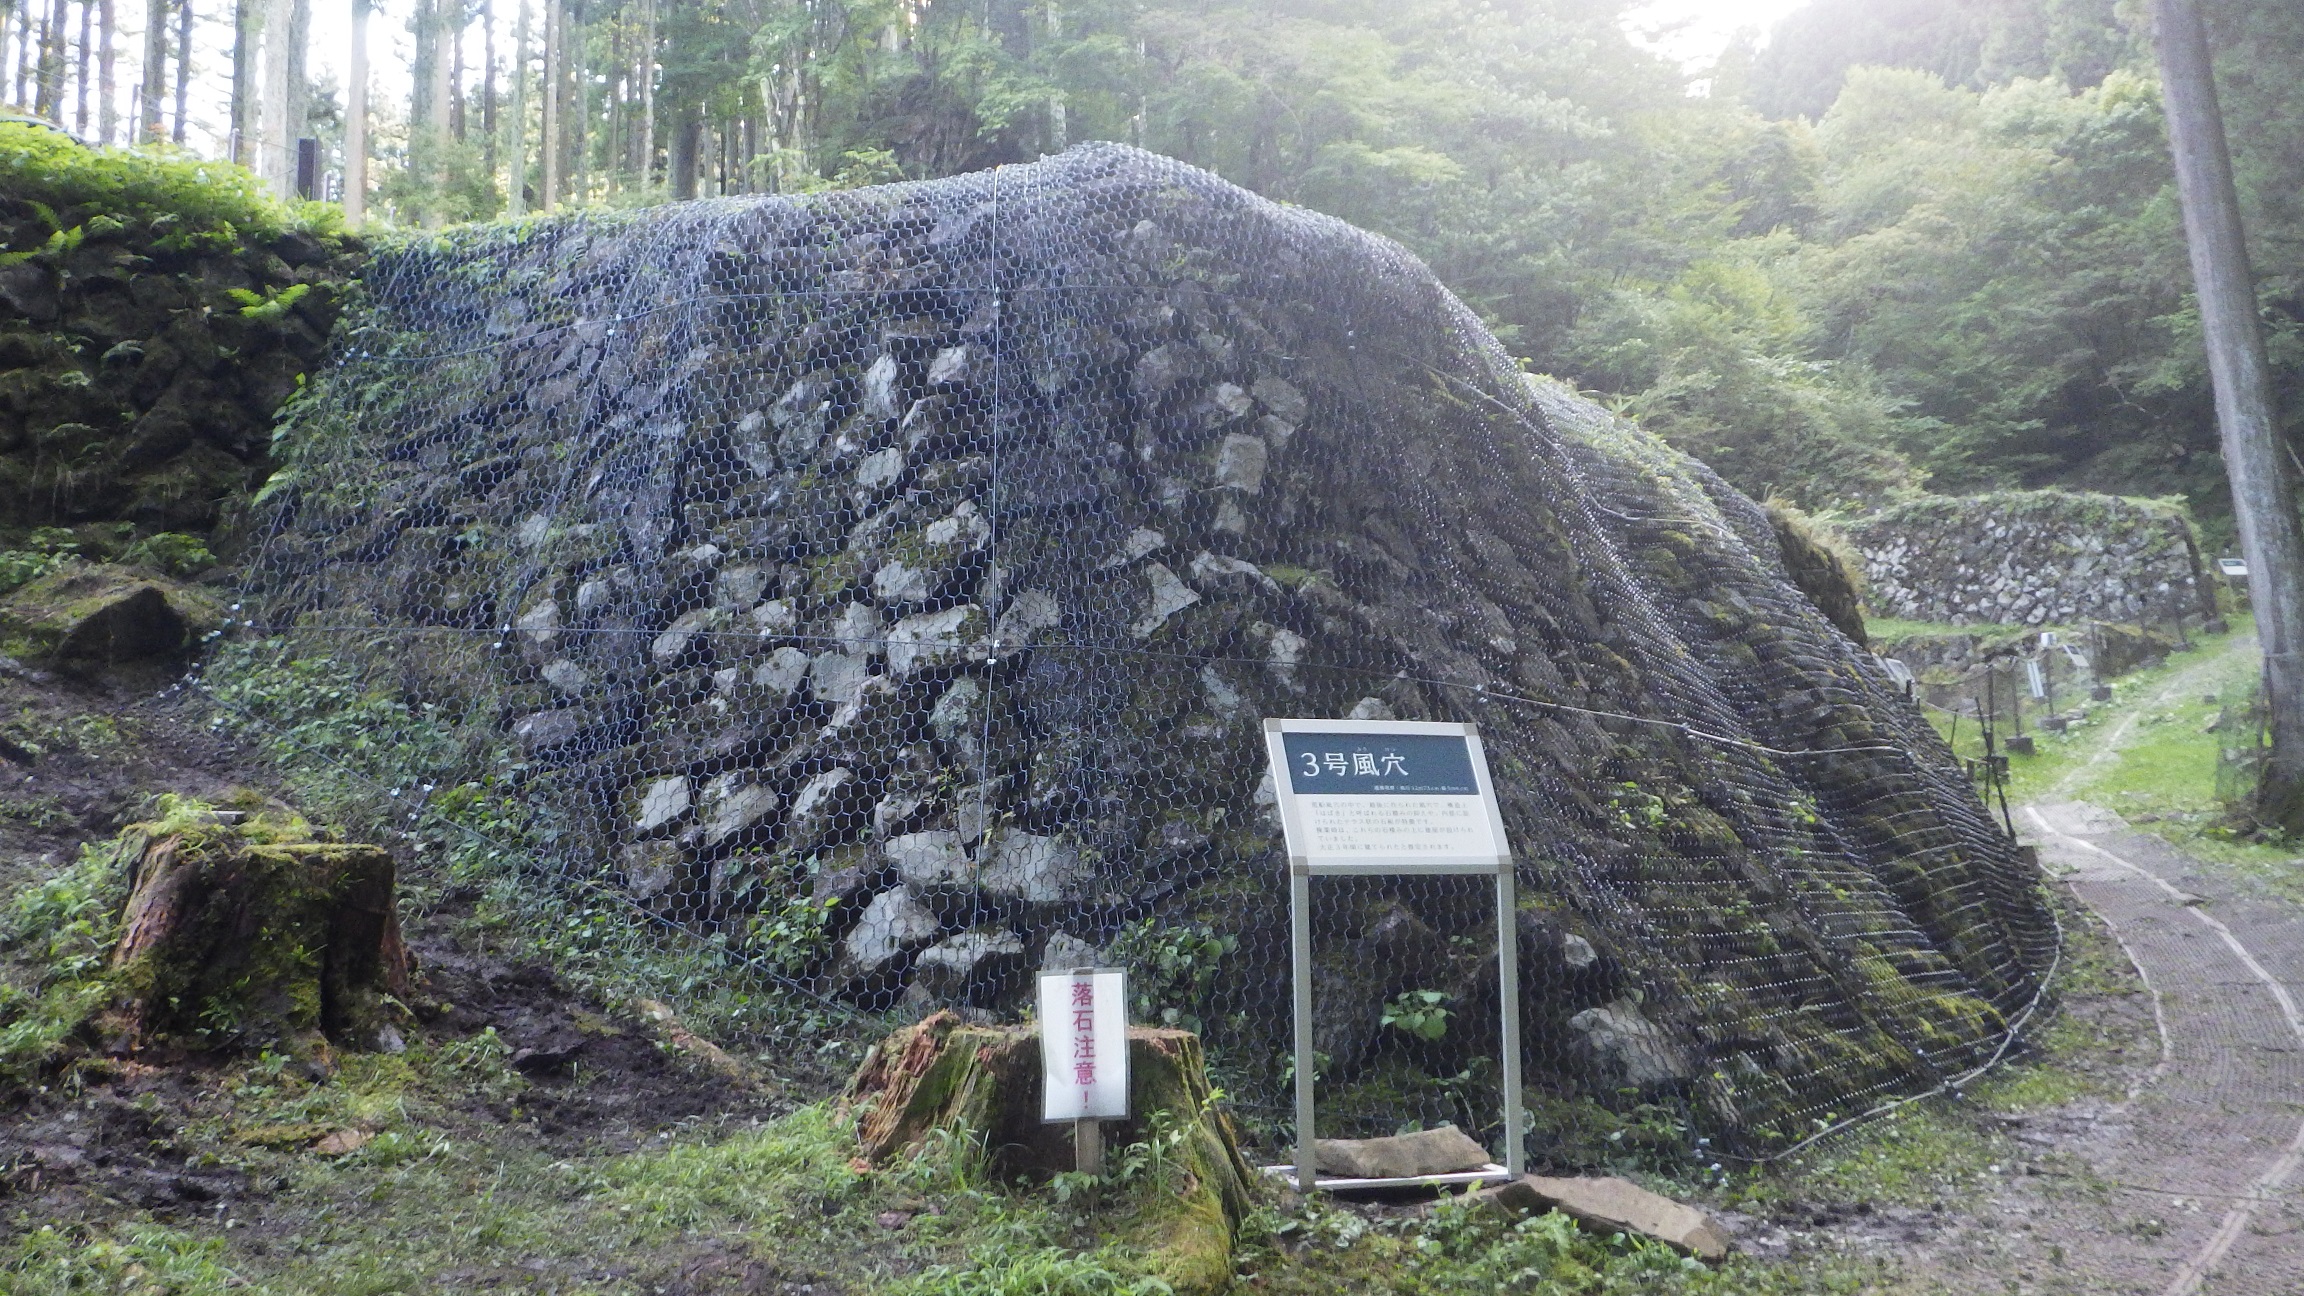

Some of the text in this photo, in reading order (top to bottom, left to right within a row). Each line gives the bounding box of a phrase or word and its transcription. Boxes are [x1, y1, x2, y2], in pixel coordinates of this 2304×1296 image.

[1300, 752, 1410, 777] 3号風穴
[1071, 982, 1097, 1109] 落石注意！
